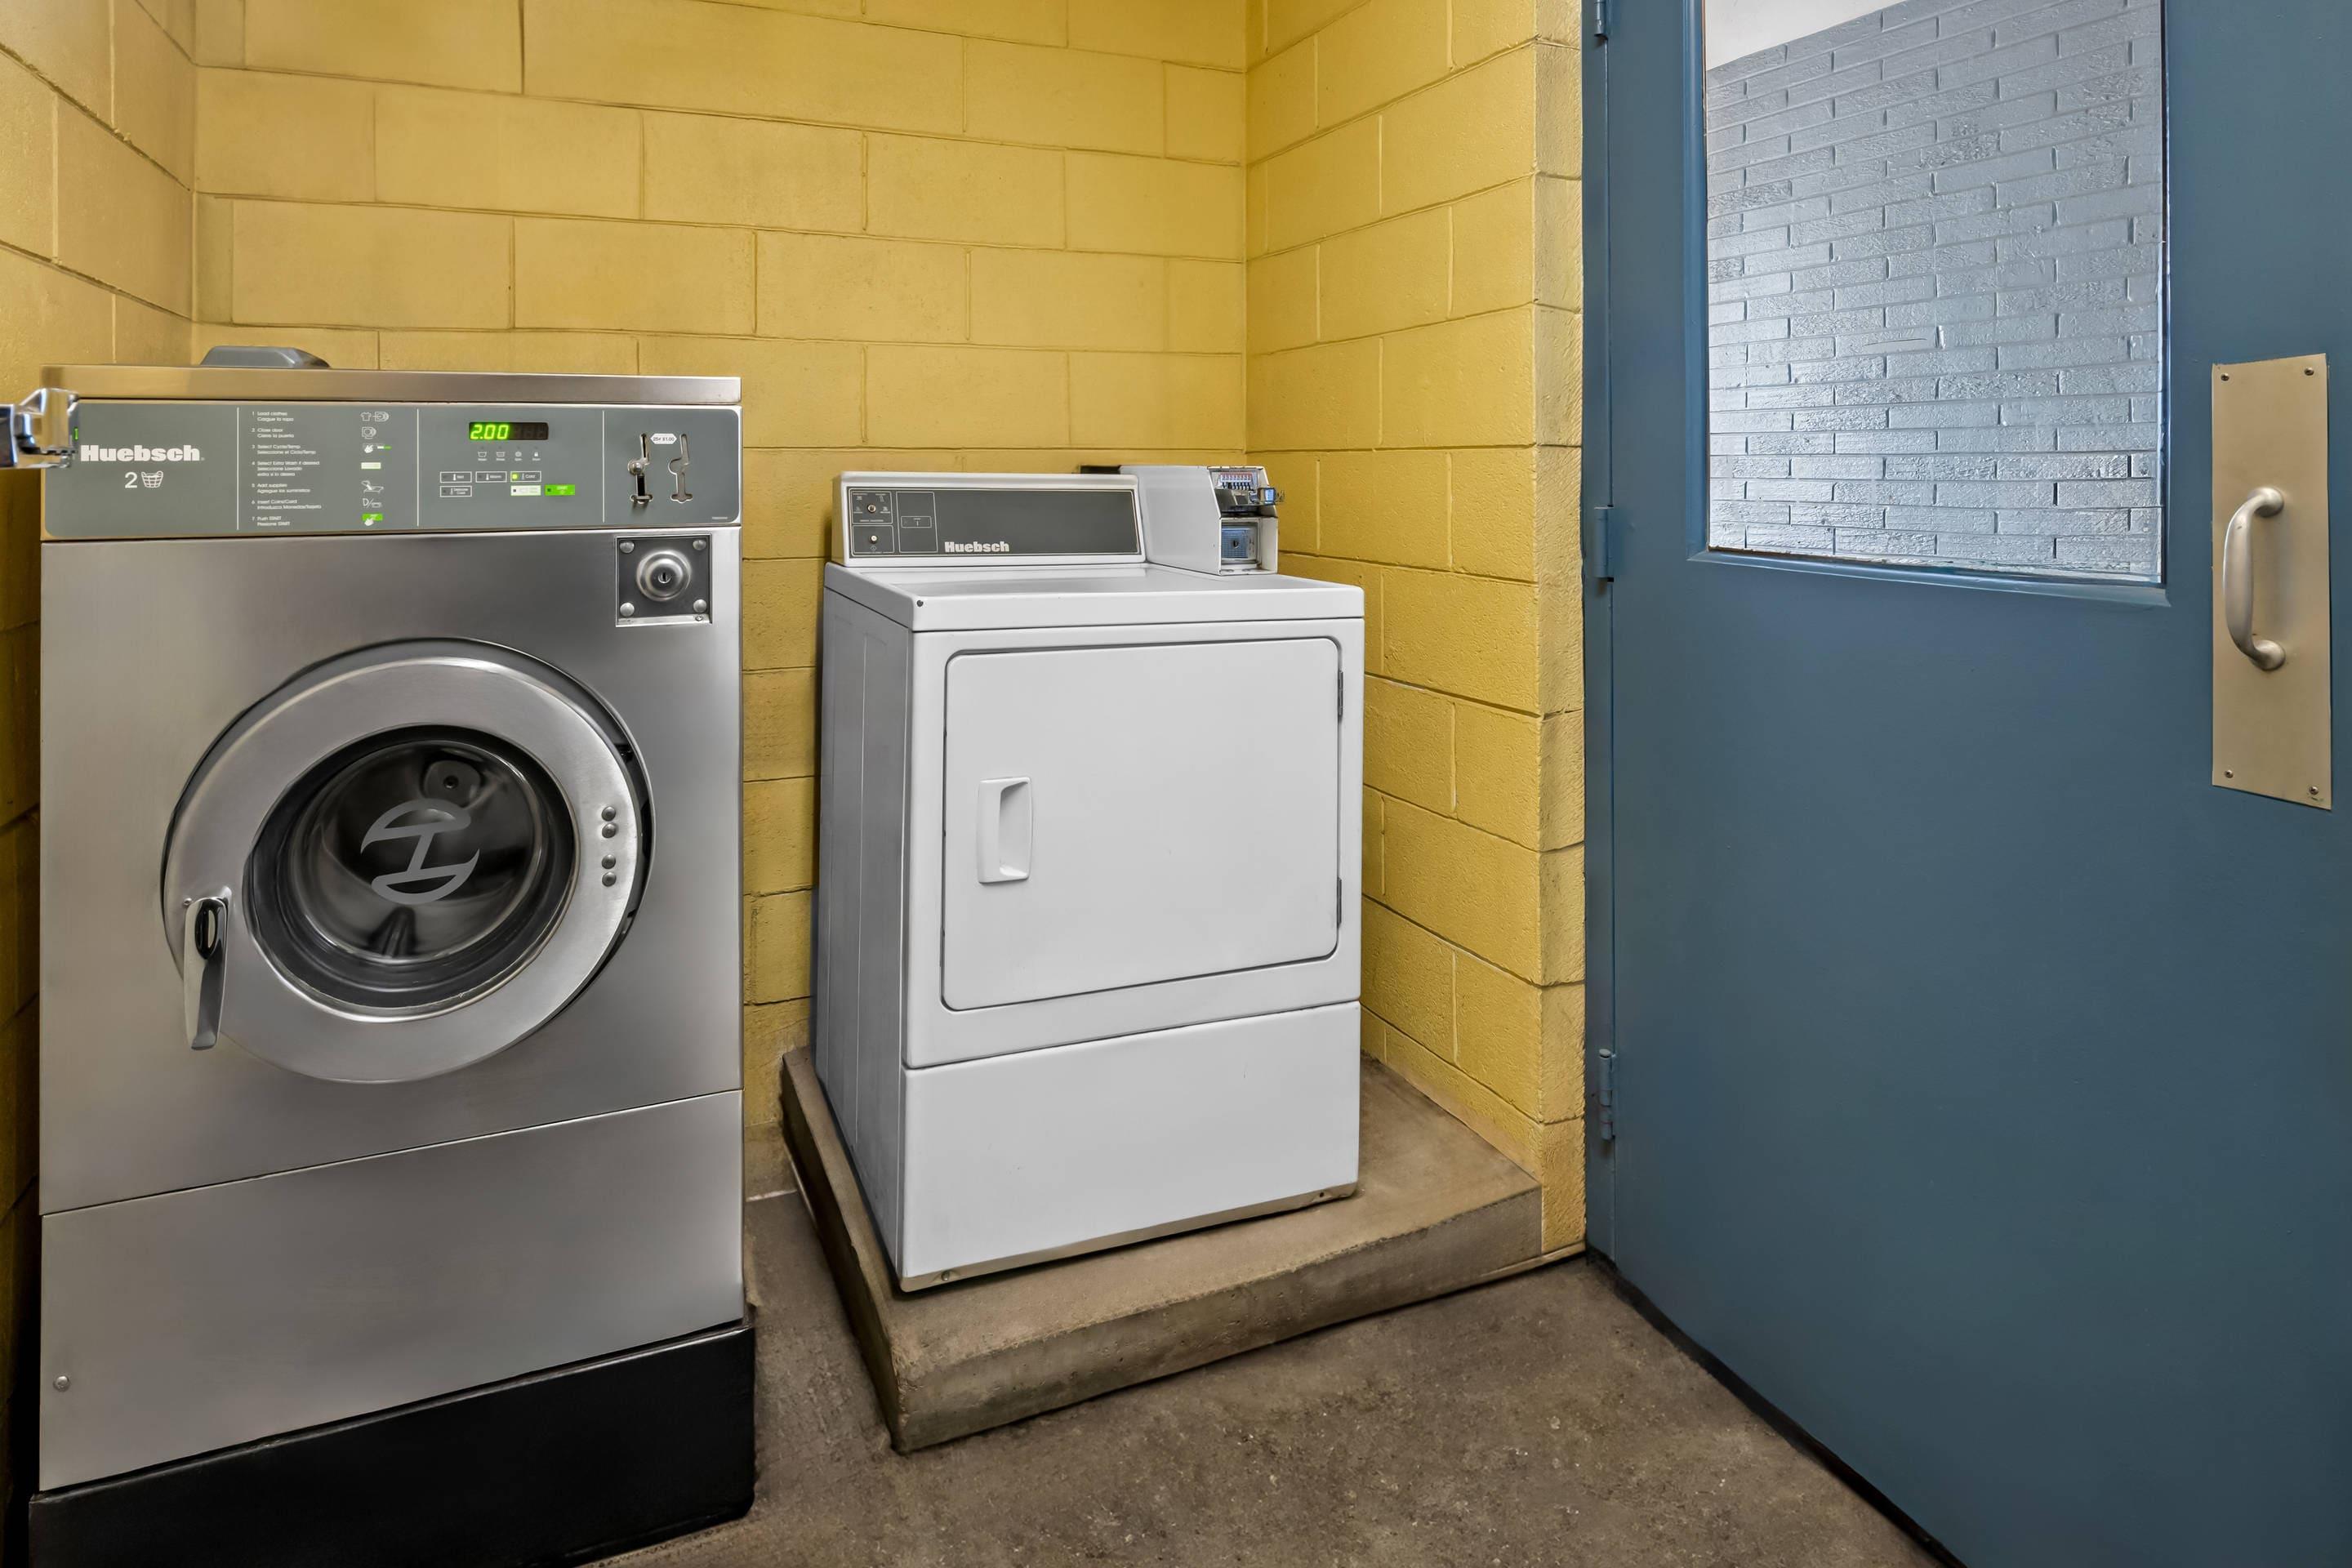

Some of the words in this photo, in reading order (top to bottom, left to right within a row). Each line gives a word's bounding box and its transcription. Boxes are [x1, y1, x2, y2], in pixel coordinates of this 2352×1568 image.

[470, 424, 510, 440] 2.00
[80, 444, 201, 462] Huebsch
[124, 471, 138, 488] 2
[944, 541, 1010, 553] Huebsch
